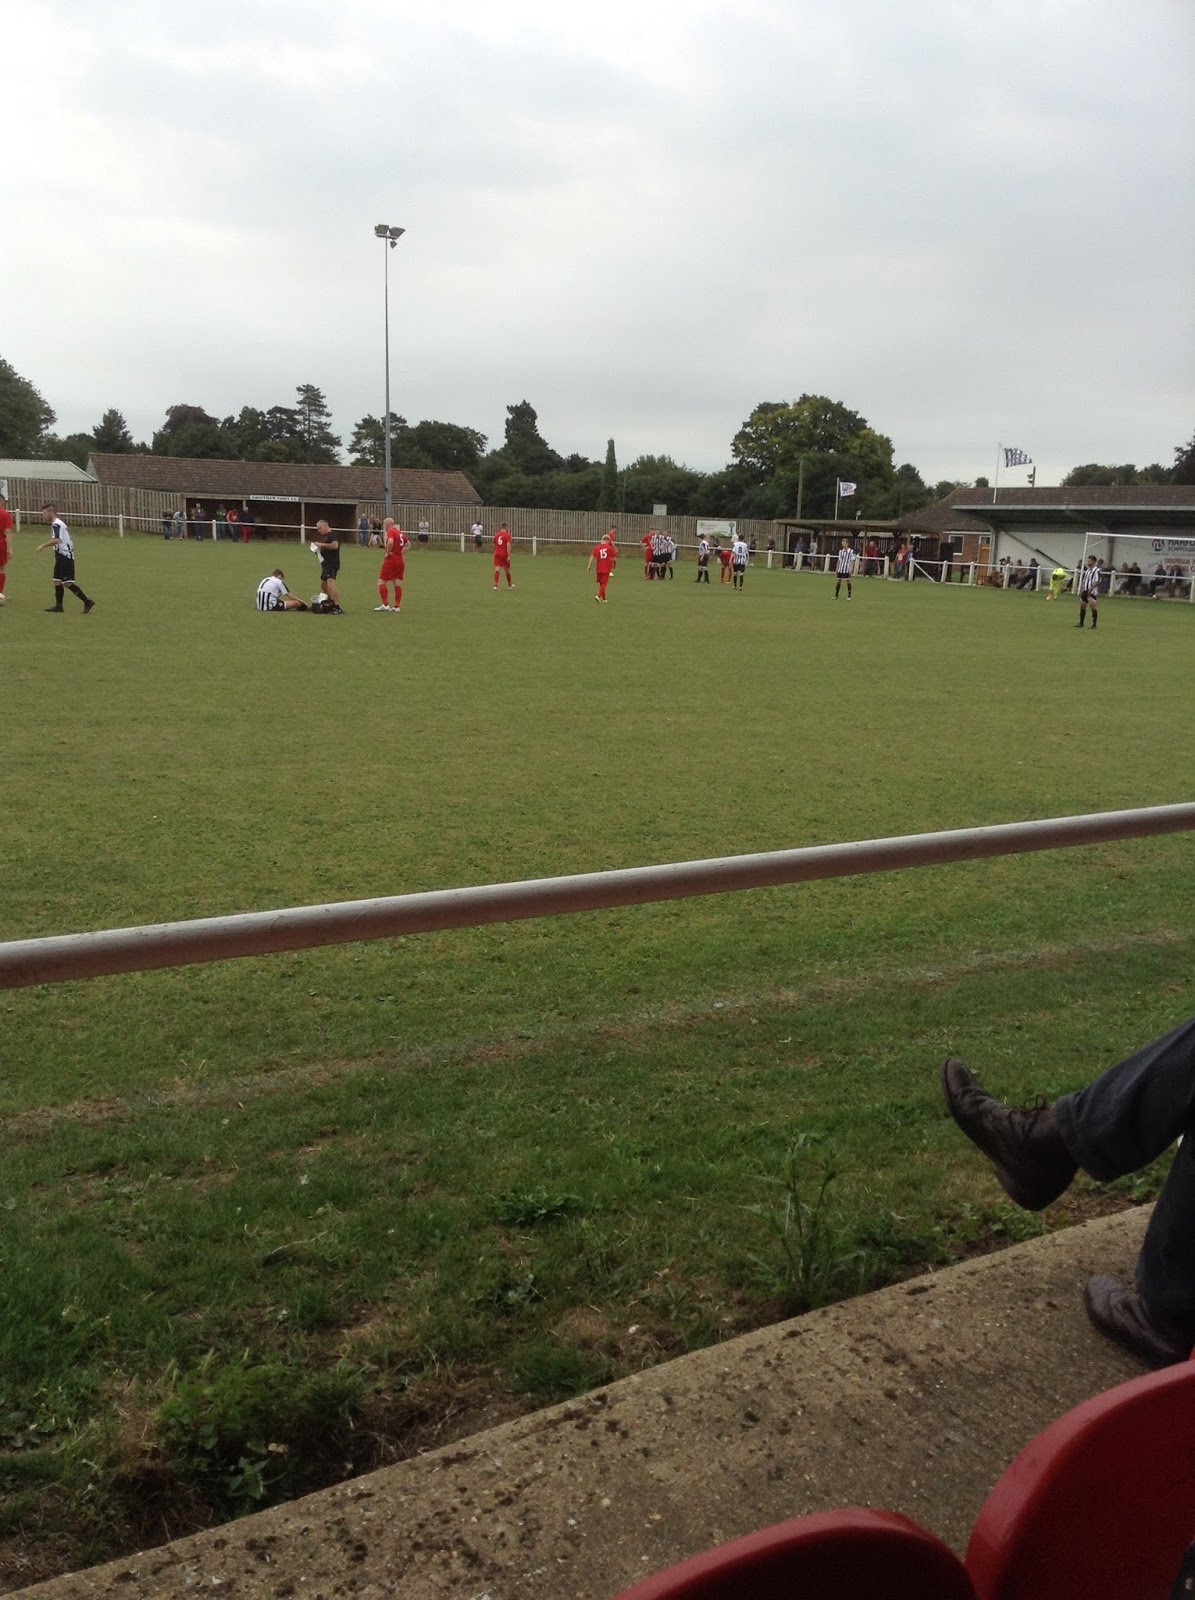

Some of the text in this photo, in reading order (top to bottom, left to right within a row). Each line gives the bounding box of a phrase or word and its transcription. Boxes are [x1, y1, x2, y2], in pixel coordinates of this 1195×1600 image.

[399, 533, 404, 546] 5
[498, 536, 503, 545] 6
[599, 548, 608, 559] 15
